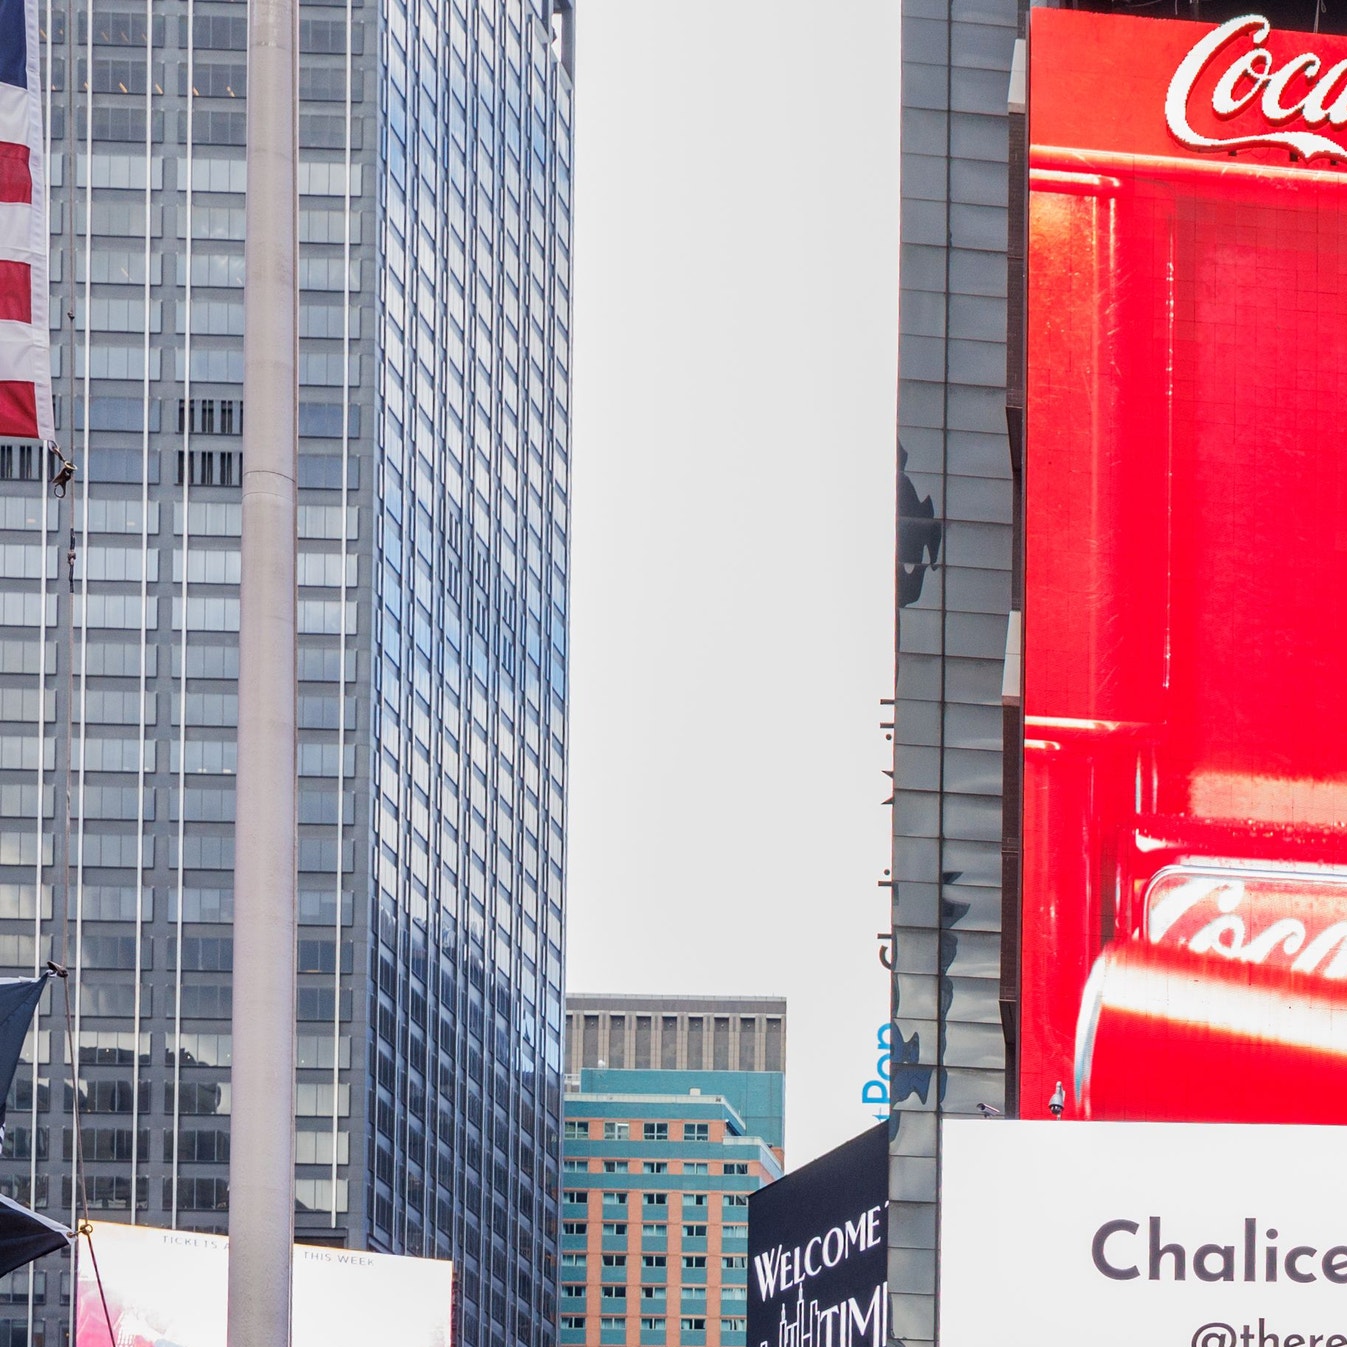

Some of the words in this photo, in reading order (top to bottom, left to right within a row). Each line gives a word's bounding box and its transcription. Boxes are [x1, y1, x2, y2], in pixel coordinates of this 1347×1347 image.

[162, 1235, 218, 1250] TICKETS
[303, 1250, 332, 1263] THIS
[337, 1254, 375, 1266] WEEK
[754, 1205, 881, 1302] WELCOME
